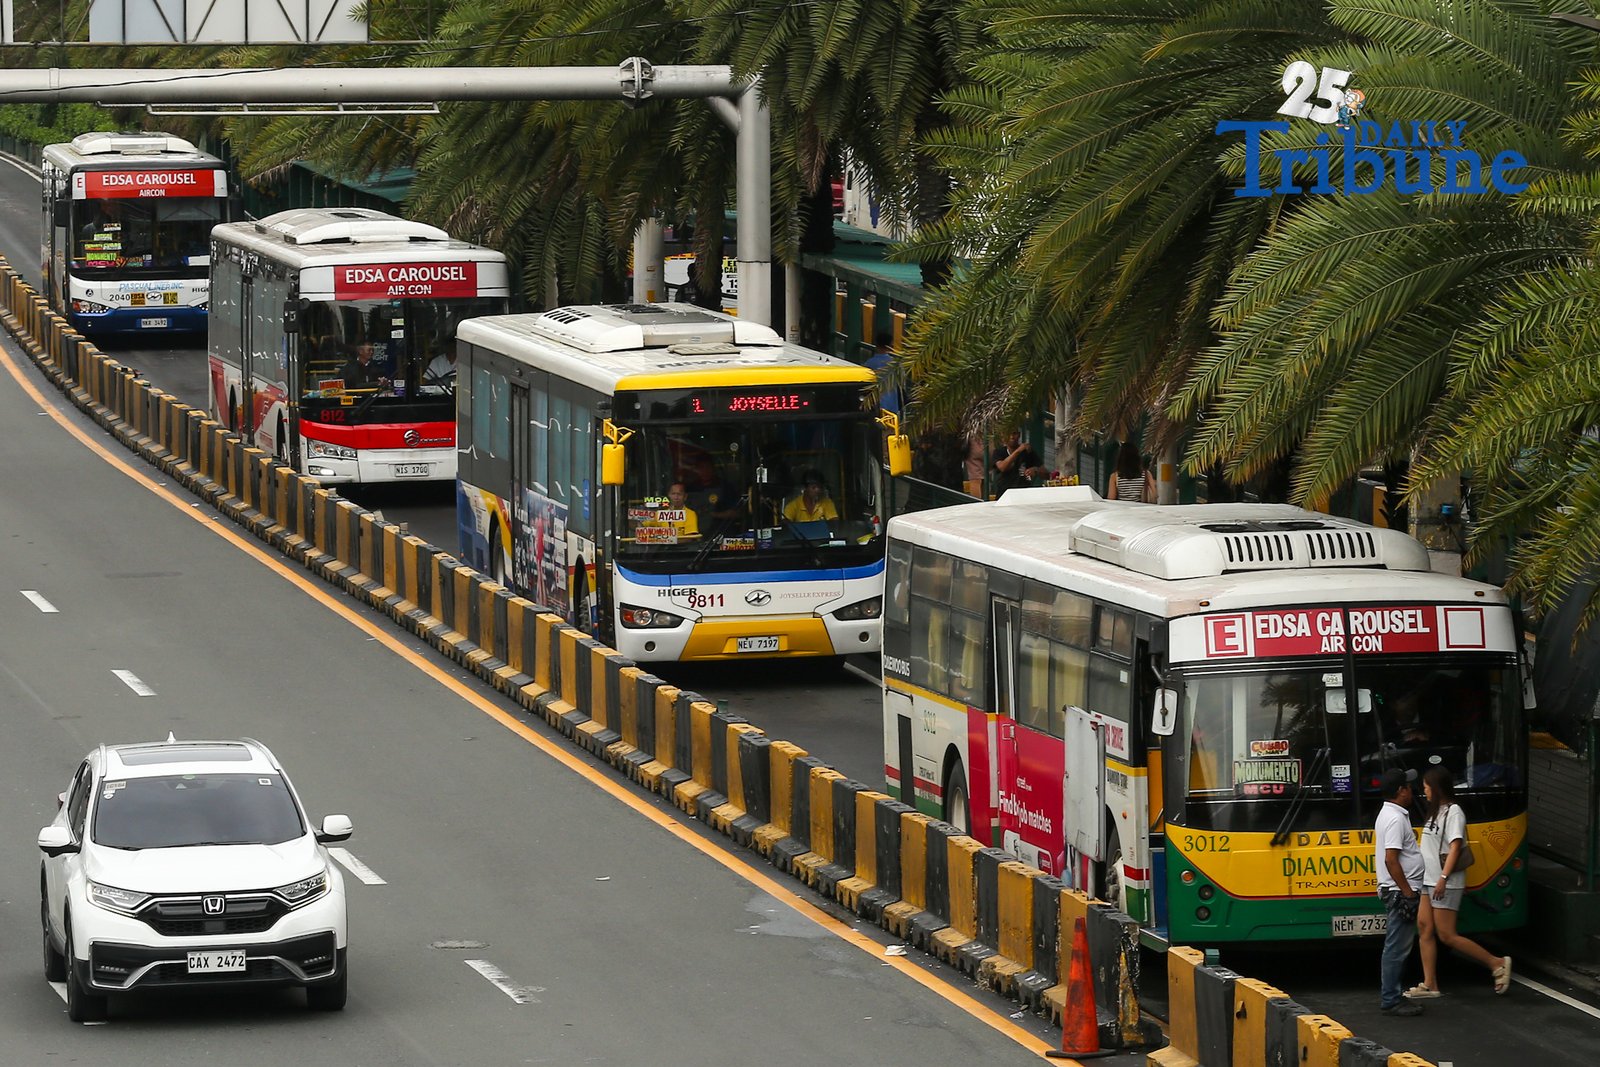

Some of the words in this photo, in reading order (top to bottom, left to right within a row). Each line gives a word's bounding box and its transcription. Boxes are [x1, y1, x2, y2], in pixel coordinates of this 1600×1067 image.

[77, 178, 83, 188] E
[102, 174, 134, 186] EDSA
[136, 173, 197, 185] CAROUSEL
[139, 188, 166, 197] AIRCON
[345, 268, 385, 284] EDSA
[388, 266, 467, 283] CAROUSEL
[387, 285, 406, 296] AIR
[408, 284, 432, 295] CON
[109, 293, 131, 302] 2040
[729, 395, 800, 412] JOYSELLE
[320, 408, 345, 422] 812
[658, 510, 685, 521] AYALA
[657, 587, 698, 598] HIGER
[779, 592, 812, 600] JOYSELLE
[812, 591, 842, 599] EXPRESS
[688, 594, 725, 609] 9811
[1256, 614, 1312, 639] EDSA
[738, 640, 753, 650] NEV
[757, 638, 779, 650] 7197
[1320, 636, 1347, 653] AIR
[1352, 635, 1383, 653] CON
[1234, 761, 1299, 783] MONUMENTO
[1243, 783, 1285, 795] MCU
[999, 790, 1013, 815] Find
[1028, 808, 1052, 836] matches
[1183, 835, 1231, 853] 3012
[1296, 879, 1361, 891] TRANSIT
[1334, 920, 1355, 933] NEM
[1360, 917, 1386, 932] 2732
[189, 956, 210, 969] CAX
[217, 955, 245, 968] 2472
